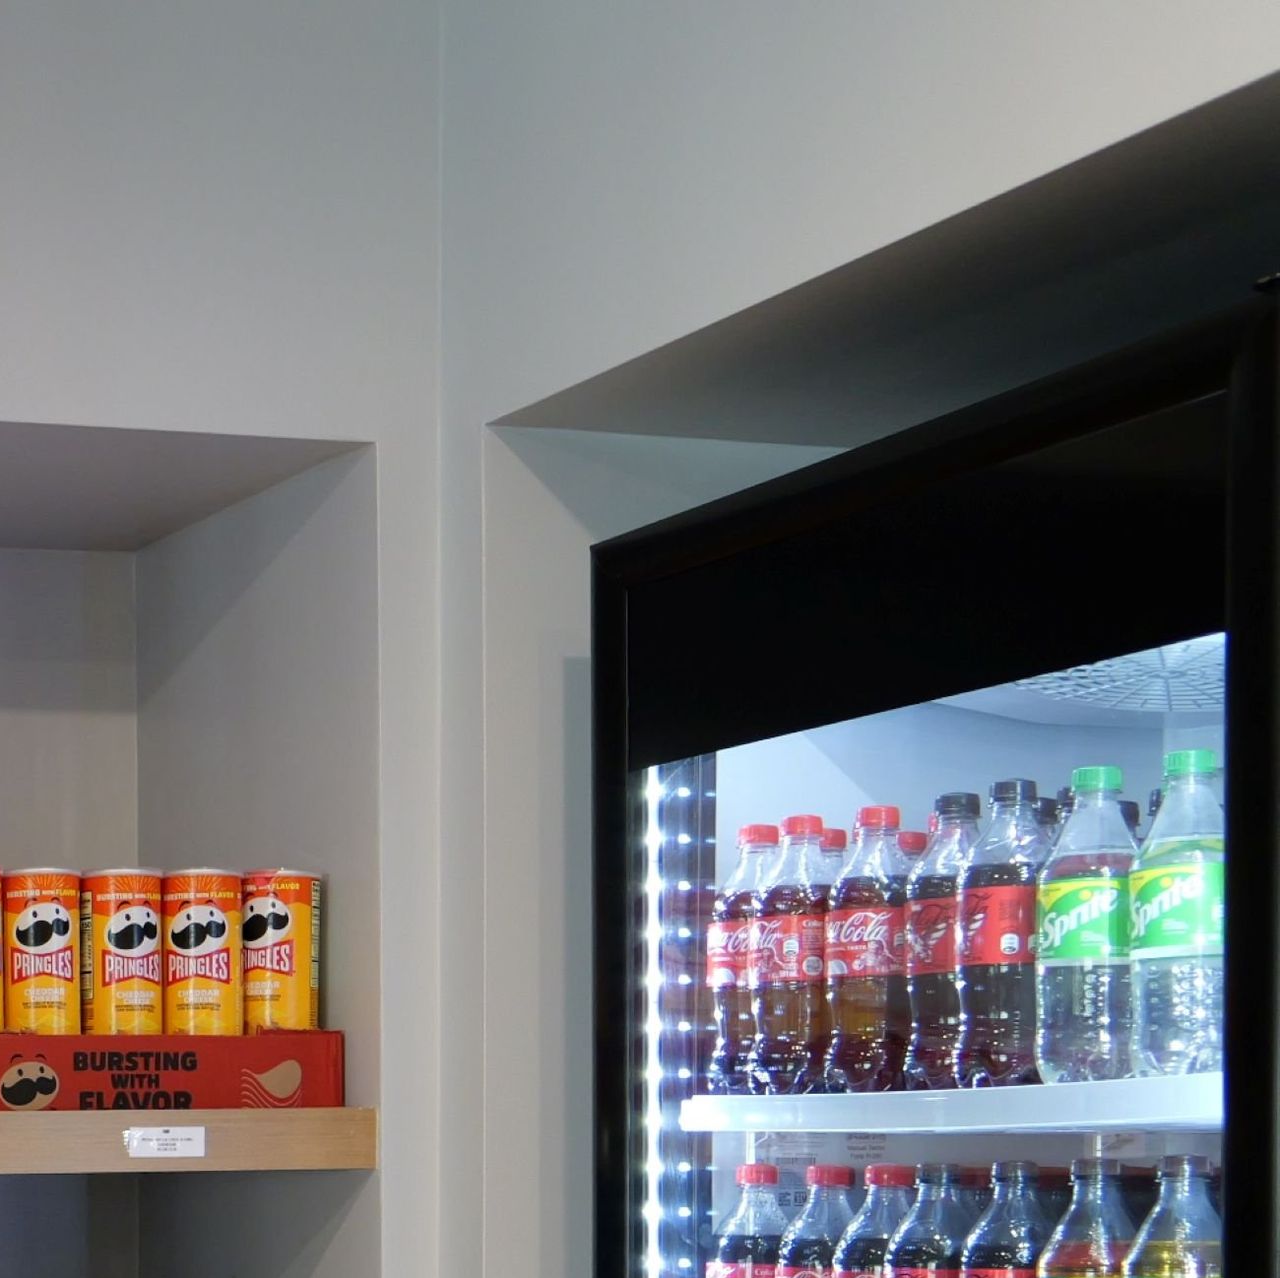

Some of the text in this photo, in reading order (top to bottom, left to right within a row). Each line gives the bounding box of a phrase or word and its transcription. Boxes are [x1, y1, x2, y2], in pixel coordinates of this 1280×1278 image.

[1042, 886, 1119, 948] Sprite
[14, 950, 72, 981] PRINGLES
[105, 951, 160, 982] PRINGLES
[168, 952, 228, 982] PRINGLES
[73, 1051, 198, 1072] BURSTING
[111, 1074, 160, 1090] WITH
[79, 1091, 192, 1111] FLAVOR
